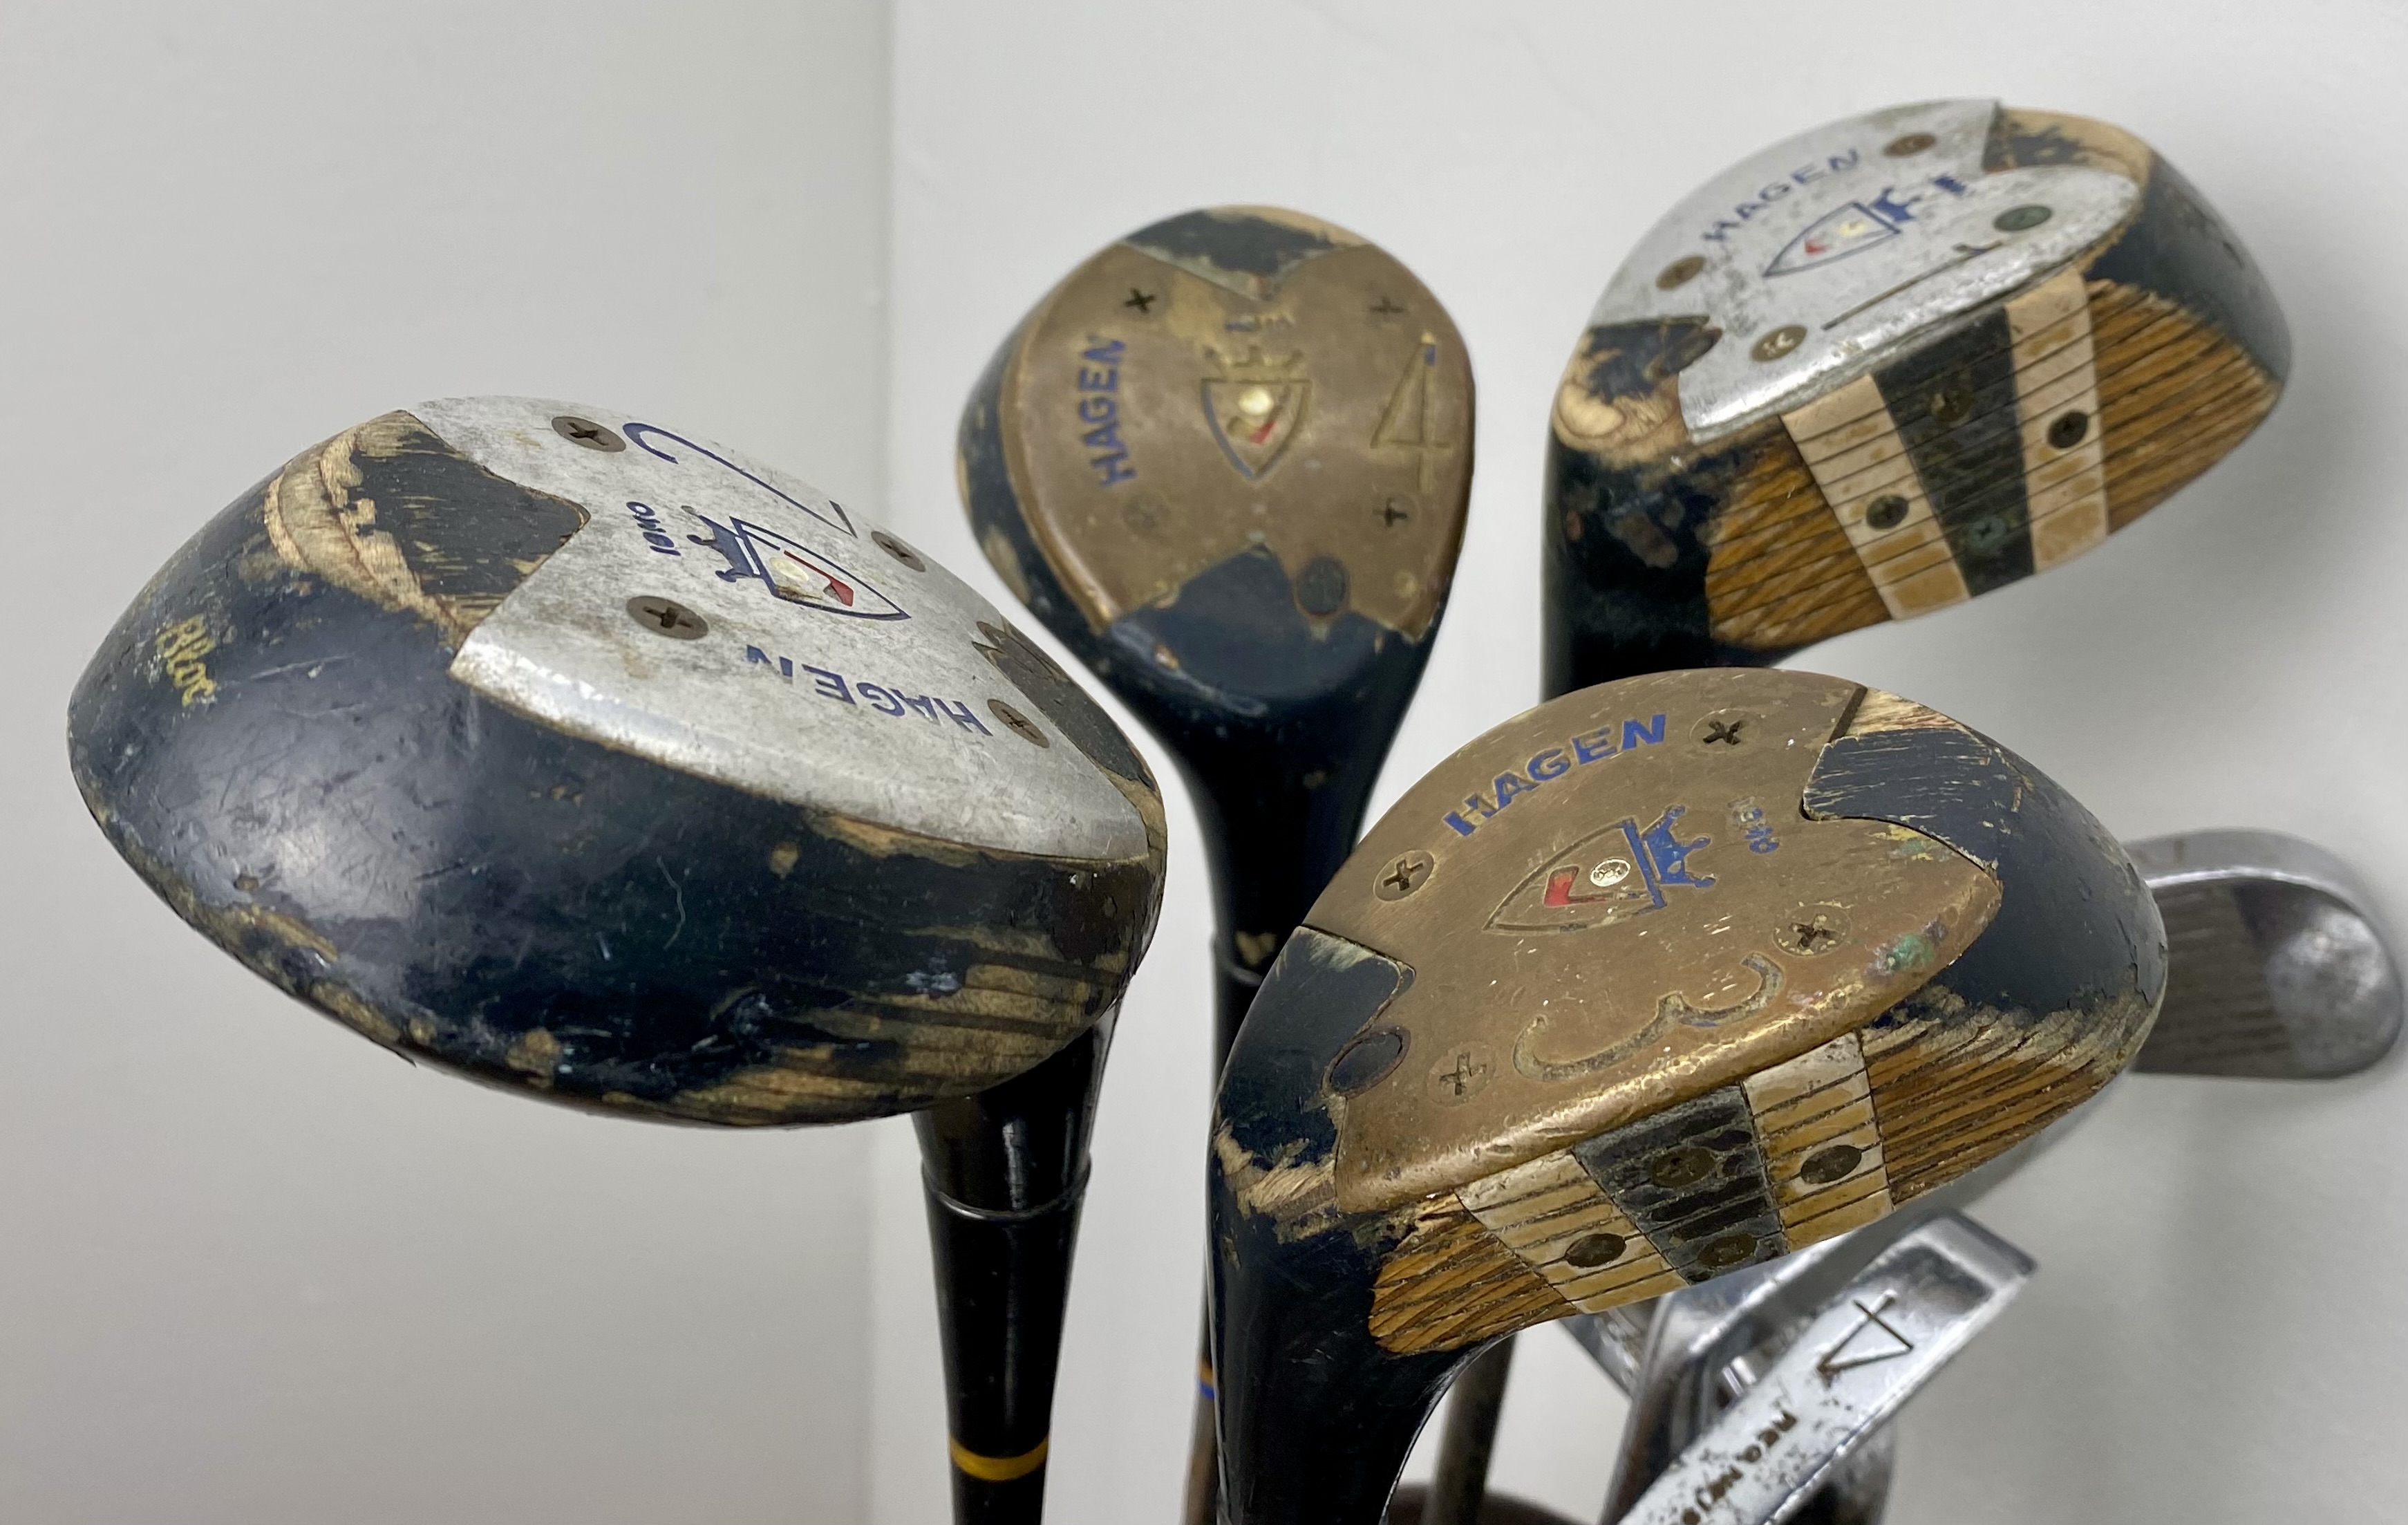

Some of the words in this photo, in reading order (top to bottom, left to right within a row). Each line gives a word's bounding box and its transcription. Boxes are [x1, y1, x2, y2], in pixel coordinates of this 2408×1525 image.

[1702, 149, 1859, 243] HAGEN
[1079, 335, 1138, 486] HAGEN
[1371, 330, 1453, 490] 4
[745, 644, 993, 737] HAGEN
[1442, 713, 1667, 837] HAGEN
[1513, 952, 1785, 1082] 3
[1818, 1290, 1914, 1374] 4
